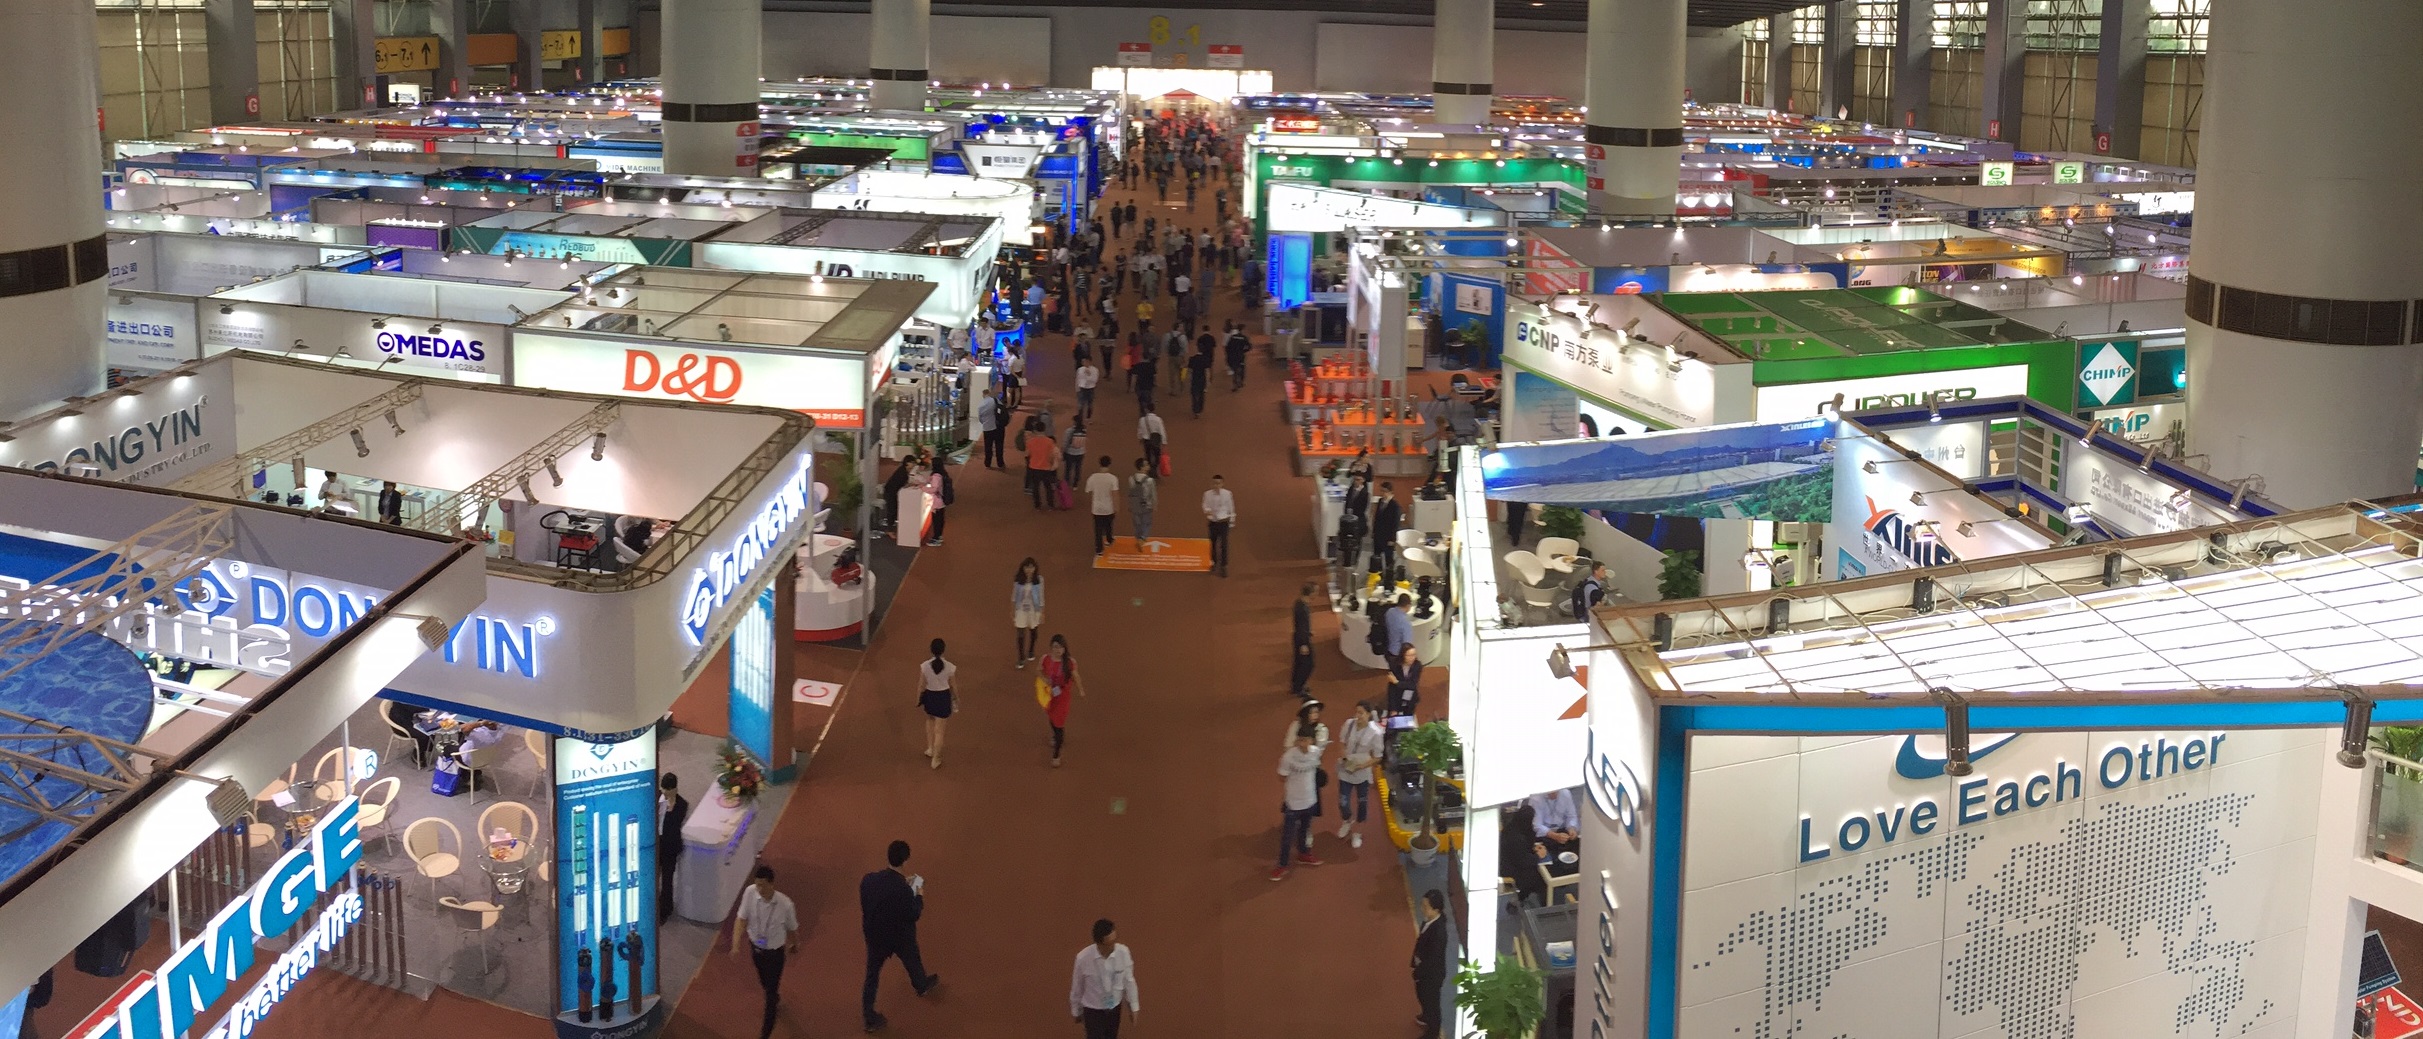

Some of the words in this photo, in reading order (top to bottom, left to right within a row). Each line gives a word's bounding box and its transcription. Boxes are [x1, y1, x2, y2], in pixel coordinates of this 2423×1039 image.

[1149, 15, 1200, 47] 8.1
[248, 98, 259, 113] G
[1991, 123, 1998, 137] H
[2099, 136, 2107, 151] G
[1530, 326, 1560, 353] CNP
[1564, 340, 1613, 374] 南方泵业
[623, 349, 742, 404] D&D
[2083, 365, 2131, 381] CHIMP
[252, 573, 538, 678] DONYIN
[1800, 796, 1938, 863] Love
[1958, 760, 2081, 826] Each
[2100, 731, 2226, 789] Other
